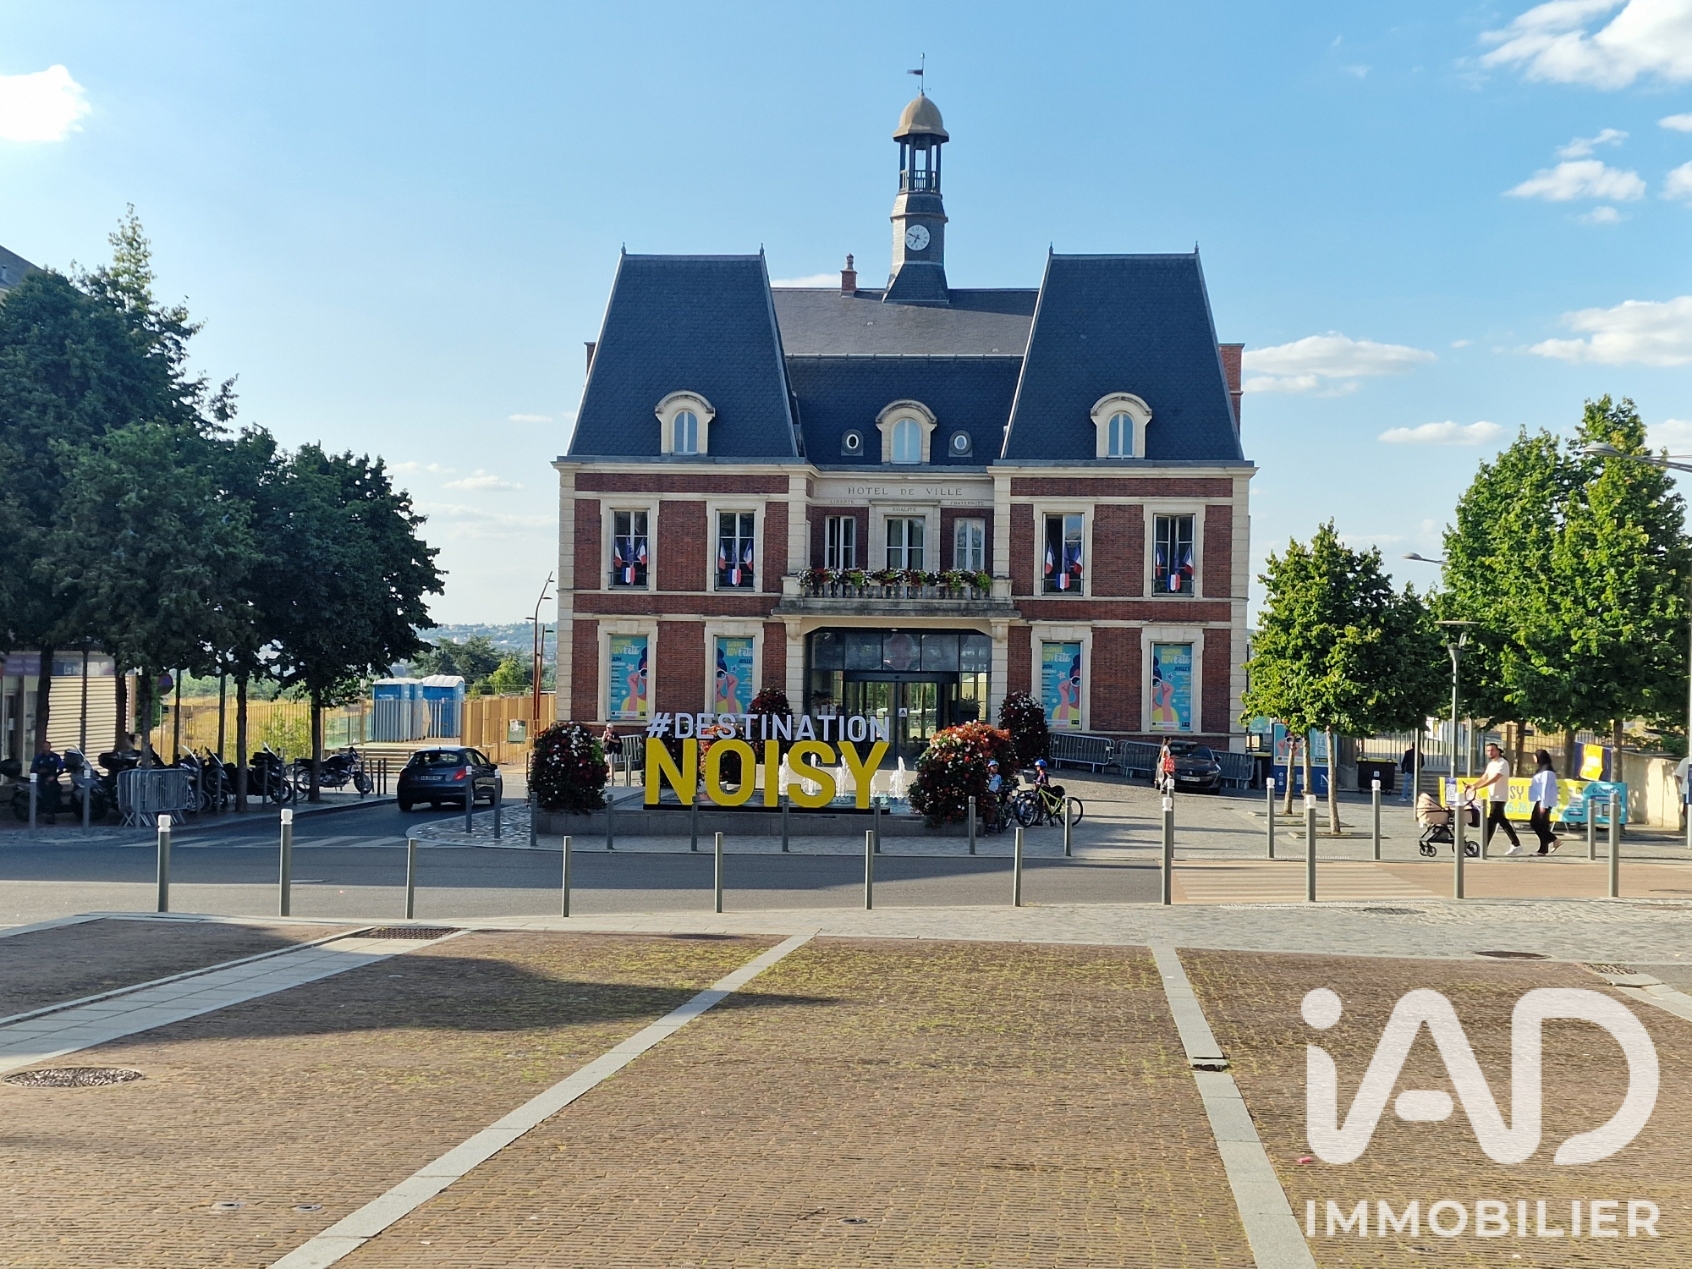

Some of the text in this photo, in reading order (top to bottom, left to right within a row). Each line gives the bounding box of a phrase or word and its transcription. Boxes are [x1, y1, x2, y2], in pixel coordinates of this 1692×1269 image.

[900, 488, 915, 496] DE
[926, 488, 963, 496] VILLE
[645, 712, 890, 743] #DESTINATION
[644, 738, 890, 810] NOISY
